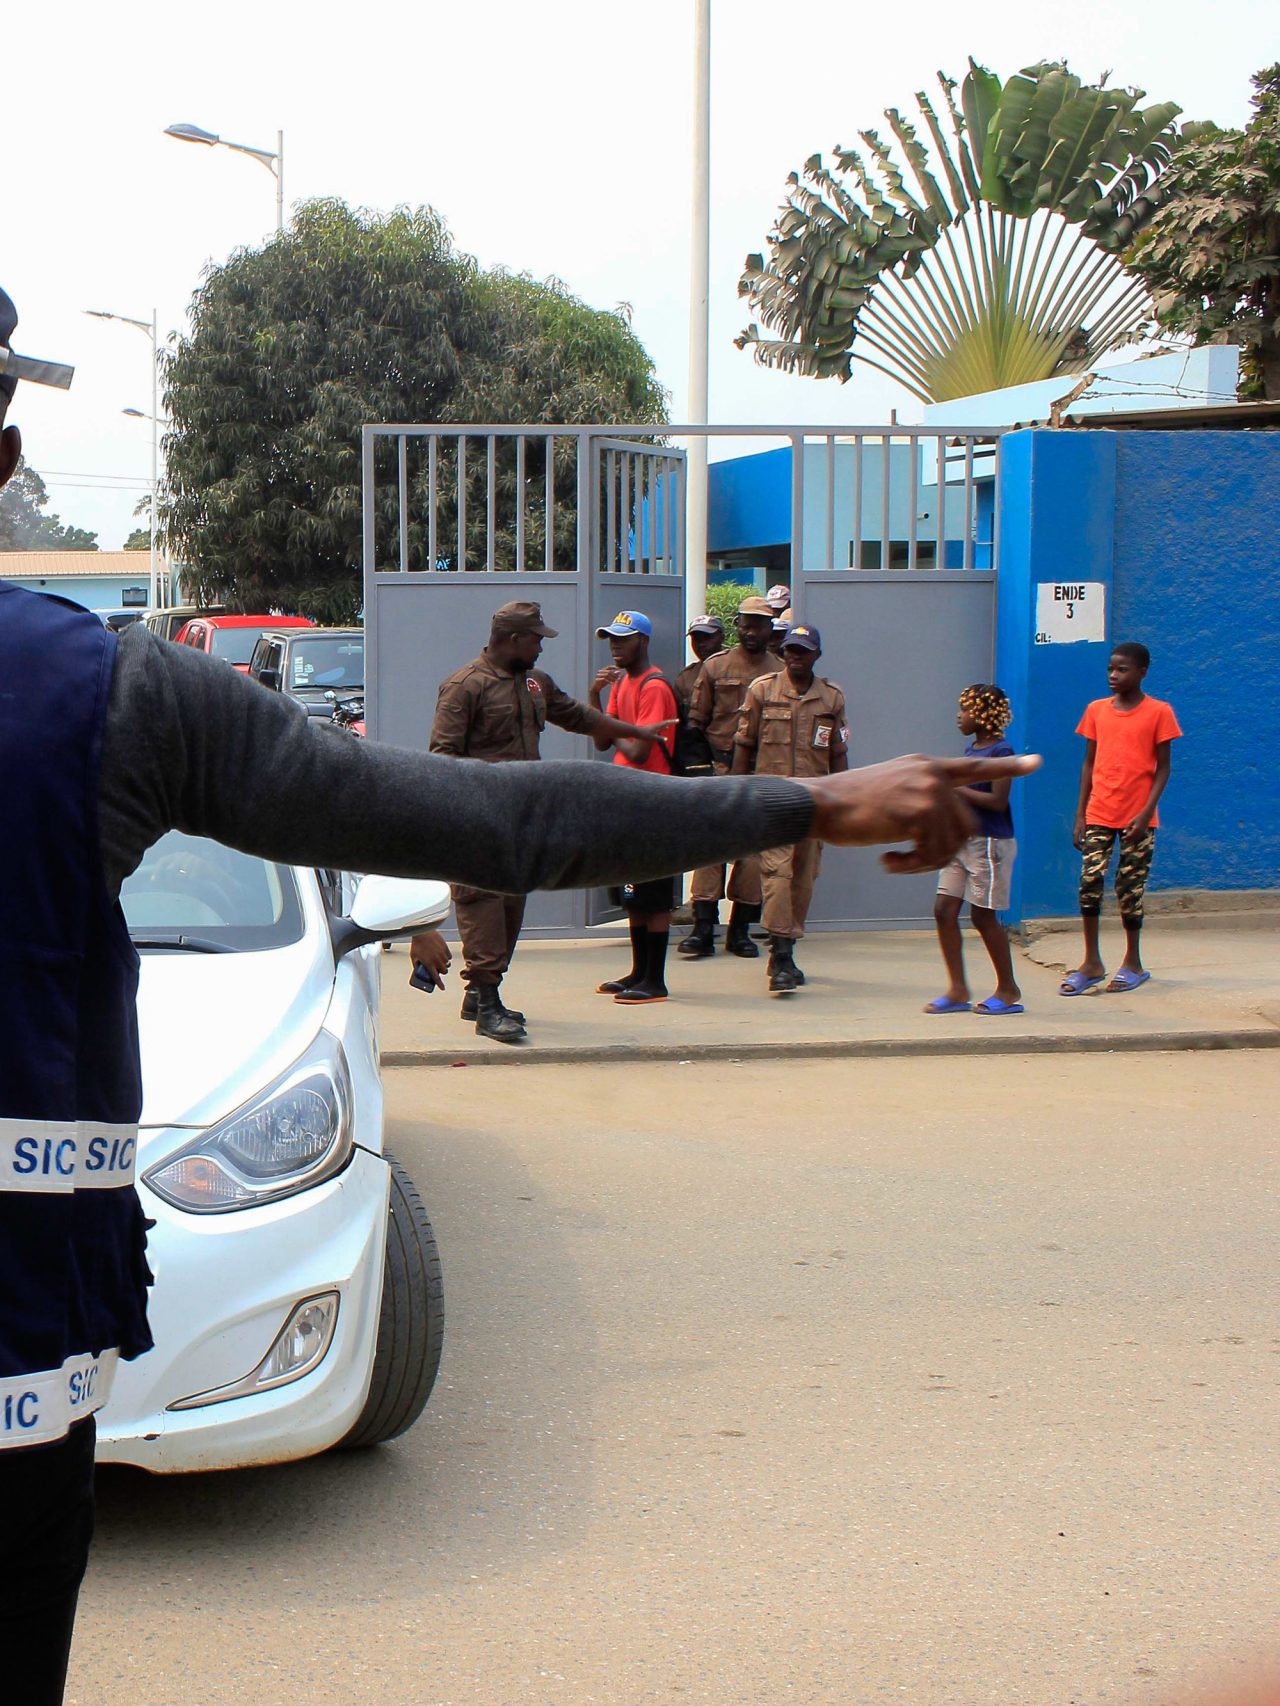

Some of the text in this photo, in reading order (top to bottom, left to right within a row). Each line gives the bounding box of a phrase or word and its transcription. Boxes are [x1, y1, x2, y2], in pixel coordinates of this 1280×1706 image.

[1054, 586, 1086, 601] ENDE
[1066, 603, 1074, 619] 3
[12, 1136, 76, 1175] SIC
[85, 1136, 135, 1172] SIC
[68, 1363, 100, 1405] SIC
